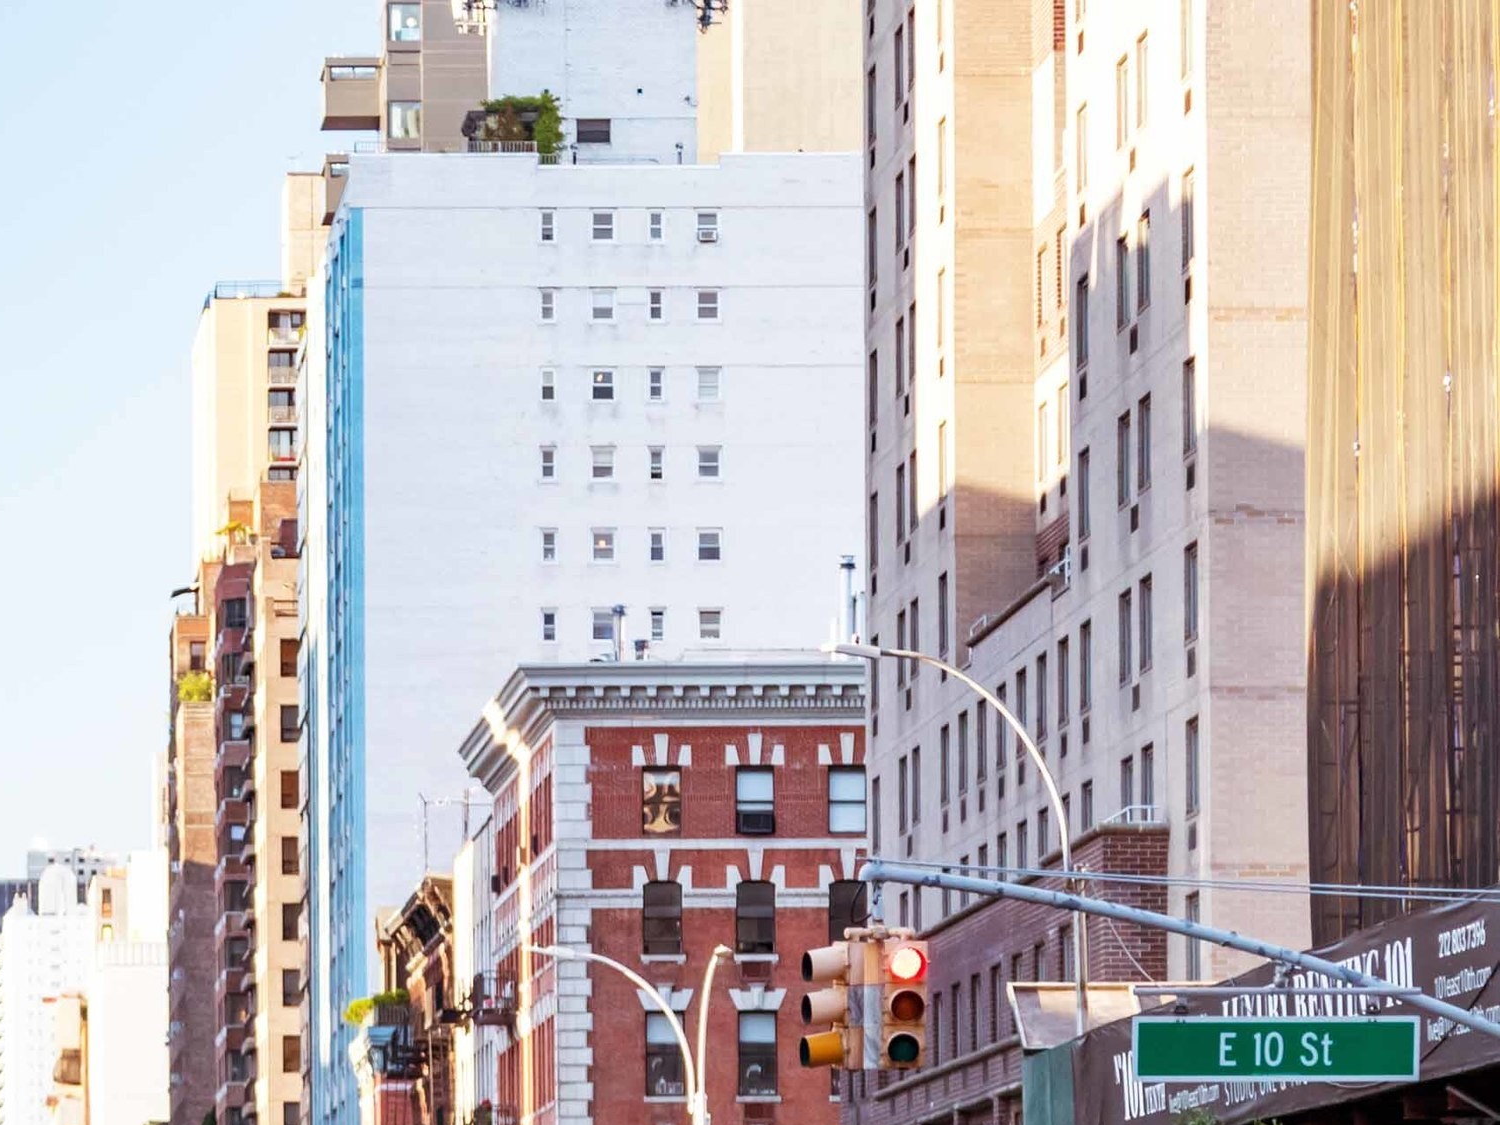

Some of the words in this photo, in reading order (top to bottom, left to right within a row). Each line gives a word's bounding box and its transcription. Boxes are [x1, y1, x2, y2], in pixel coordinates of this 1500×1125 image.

[1219, 1032, 1237, 1067] E
[1254, 1032, 1283, 1067] 10
[1300, 1032, 1333, 1067] St
